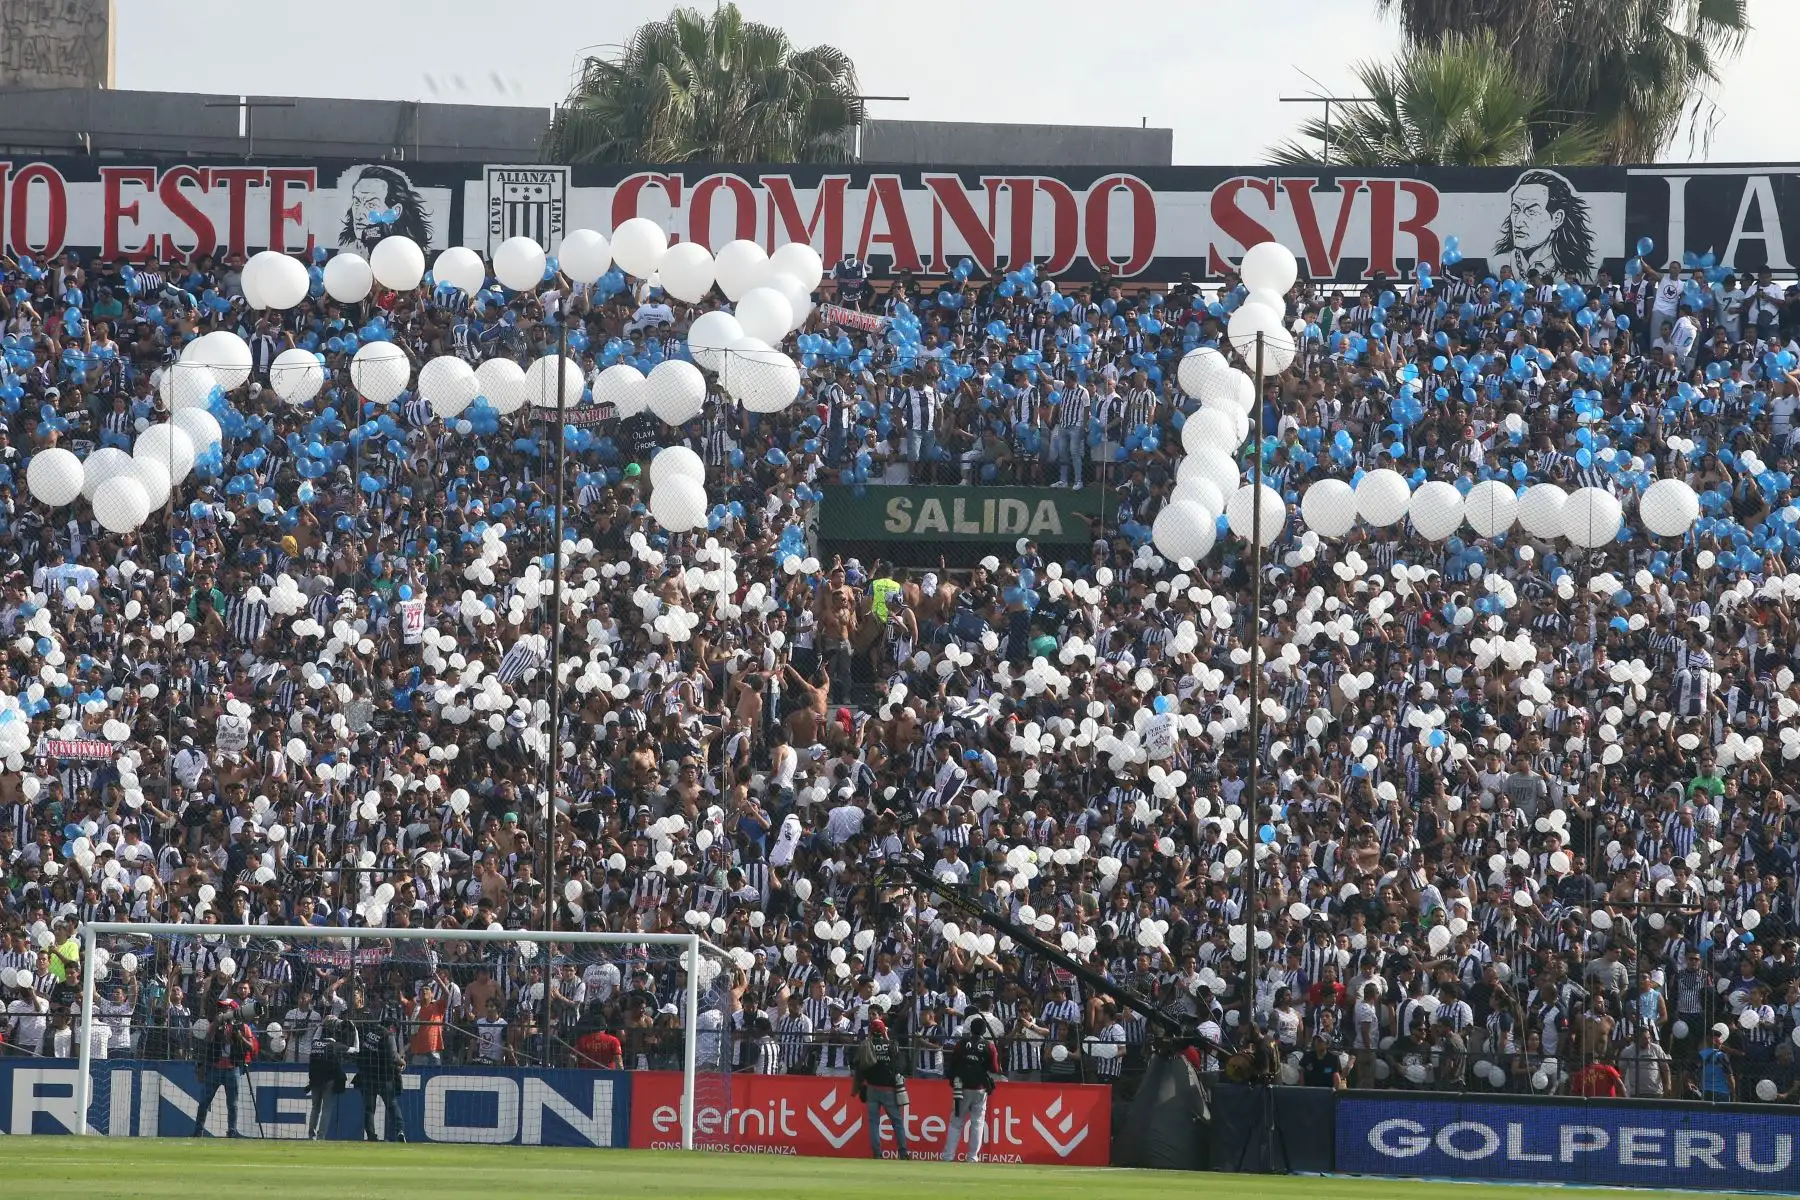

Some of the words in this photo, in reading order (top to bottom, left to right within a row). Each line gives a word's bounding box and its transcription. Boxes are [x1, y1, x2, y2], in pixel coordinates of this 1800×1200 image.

[497, 172, 556, 183] ALIANZA
[0, 161, 67, 262] O
[99, 166, 318, 266] ESTE
[491, 196, 501, 235] CLVB
[551, 198, 562, 234] LIMA
[610, 172, 1158, 279] COMANDO
[1209, 176, 1441, 281] SVR
[632, 430, 655, 440] OLAYA
[884, 496, 1063, 535] SALIDA
[407, 611, 422, 629] 27
[48, 740, 113, 757] RINCONADA
[653, 1098, 798, 1137] eernit
[651, 1141, 730, 1153] CONSUIMOS
[733, 1144, 797, 1155] CONFIANZA
[1368, 1118, 1792, 1173] GOLPERU
